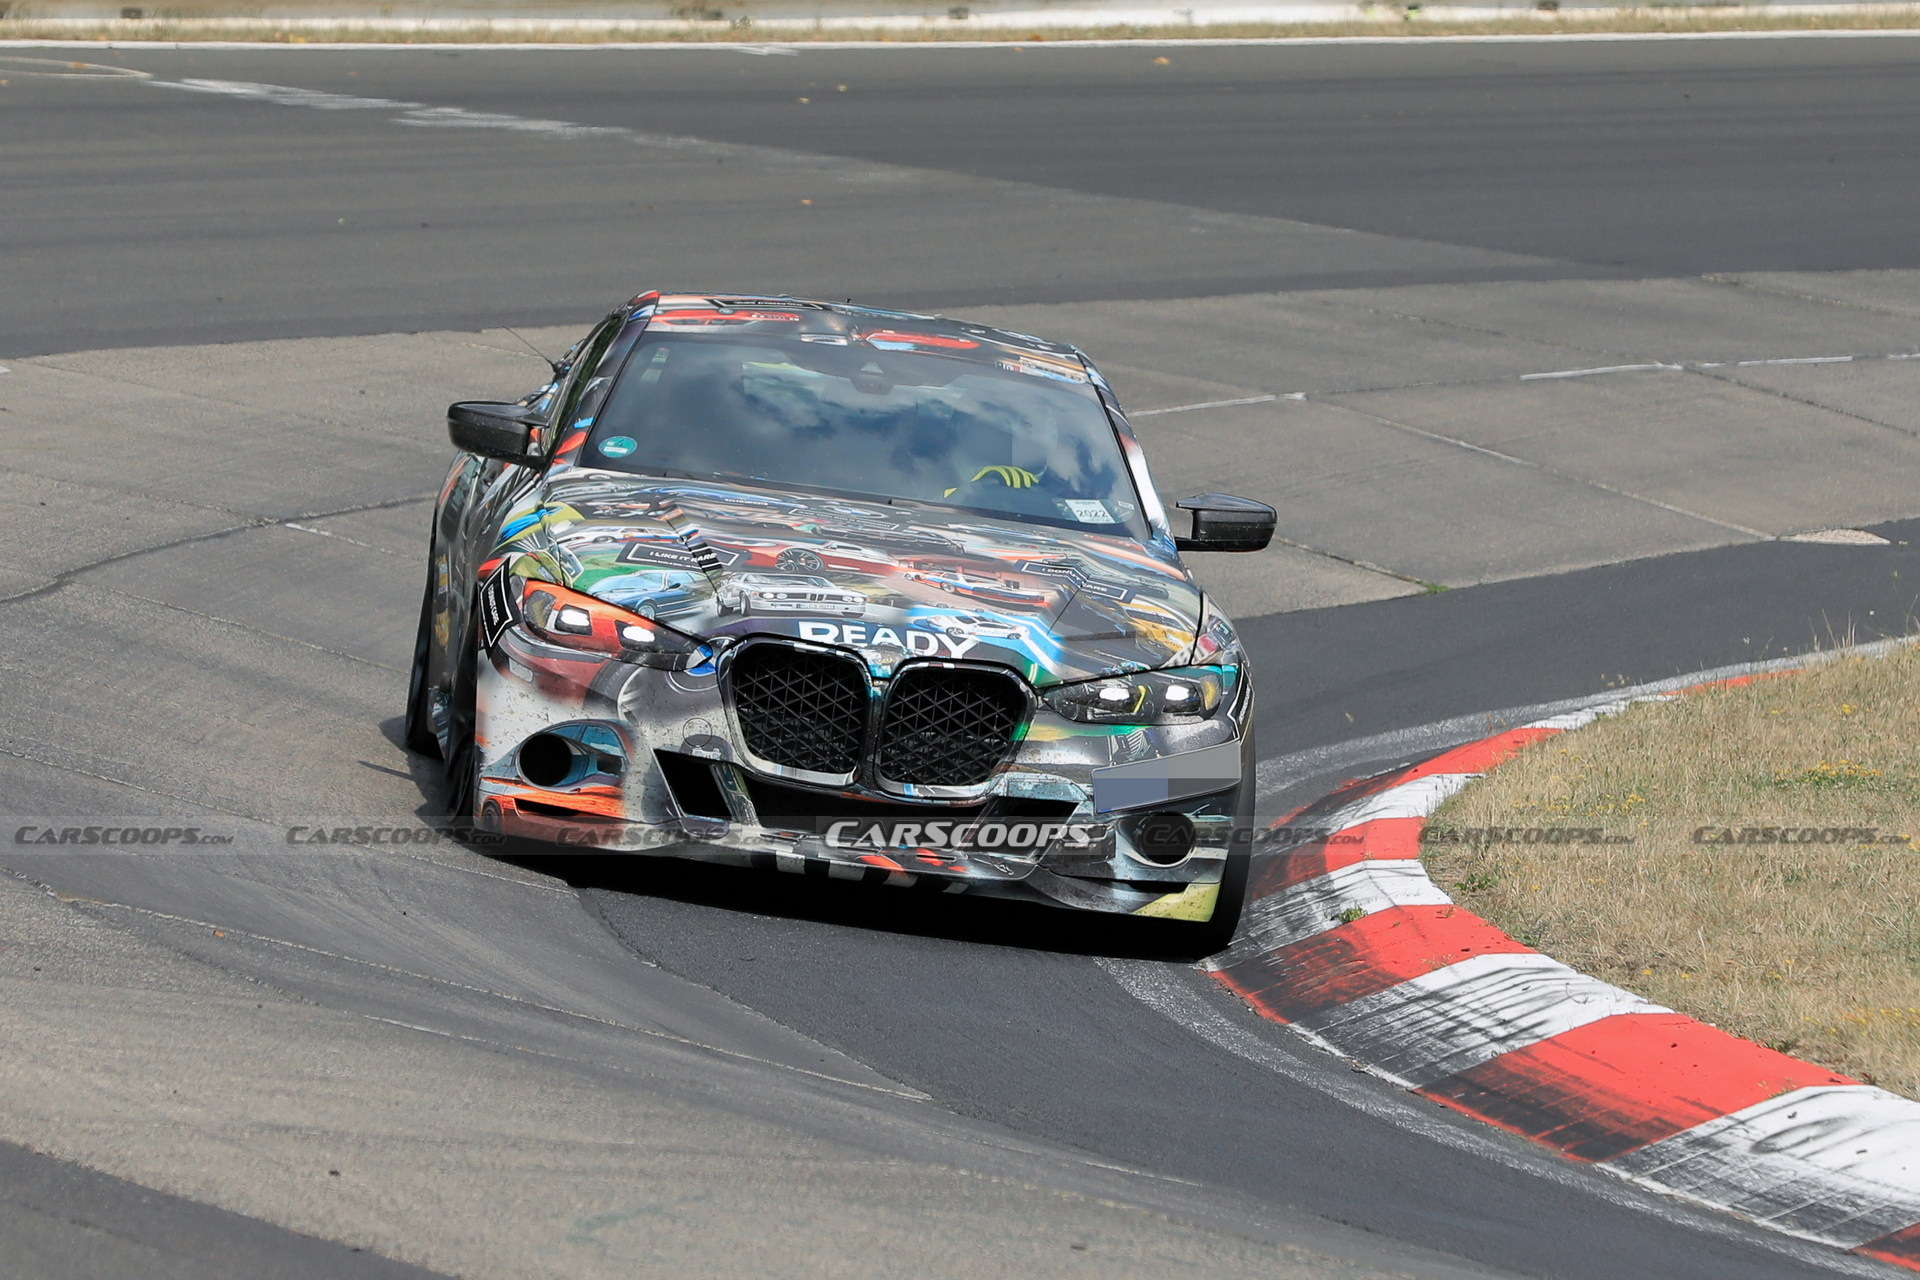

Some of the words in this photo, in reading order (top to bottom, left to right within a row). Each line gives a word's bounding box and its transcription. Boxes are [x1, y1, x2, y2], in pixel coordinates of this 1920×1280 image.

[1076, 509, 1108, 518] 2022
[655, 552, 678, 560] LIKE
[798, 621, 979, 659] READY
